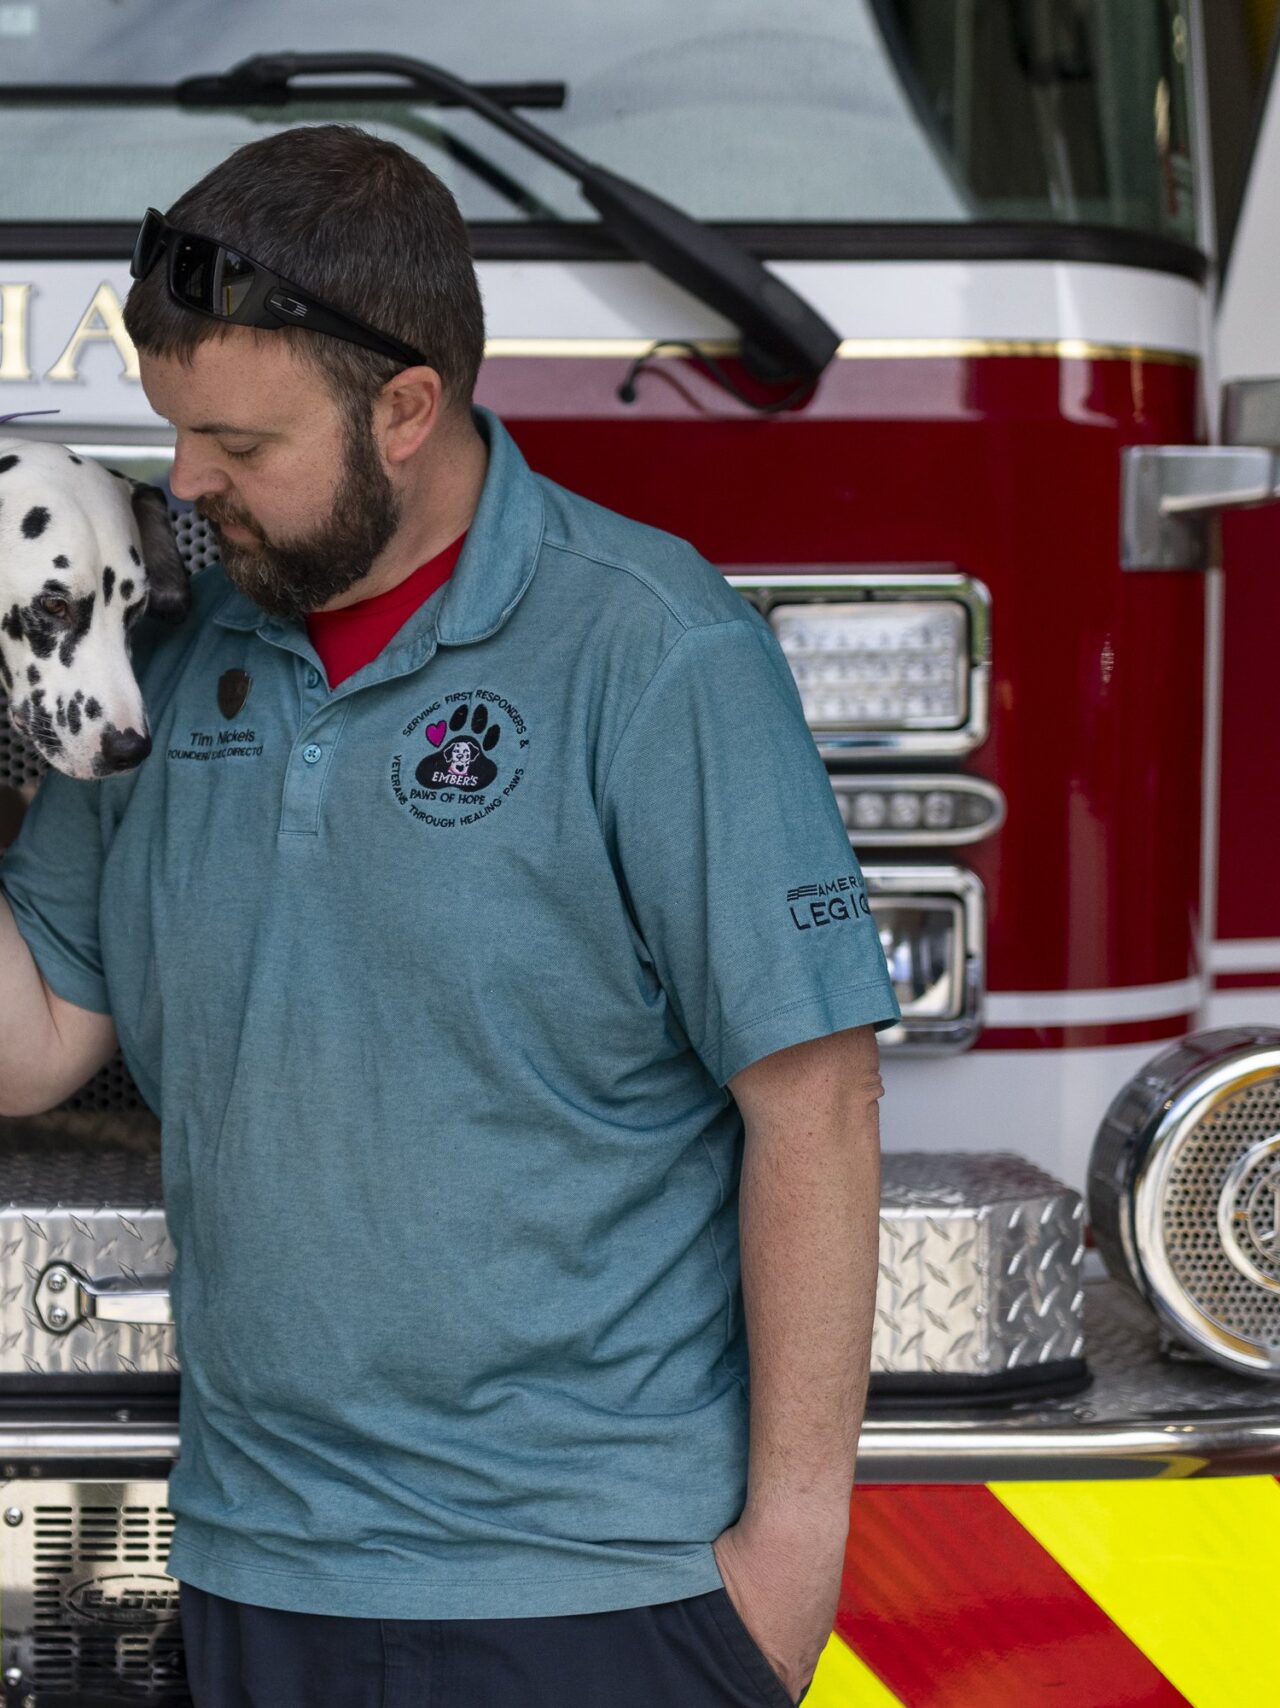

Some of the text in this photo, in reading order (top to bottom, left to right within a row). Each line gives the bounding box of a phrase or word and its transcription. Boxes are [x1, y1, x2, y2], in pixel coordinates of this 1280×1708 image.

[402, 689, 529, 749] SERVING FIRST RESPONDERS &
[190, 733, 212, 746] Tim
[227, 745, 264, 757] DIRECTO
[431, 771, 478, 786] EMBER'S
[391, 754, 524, 827] VETERANS THROUGH HEALING PAWS
[410, 789, 485, 805] PAWS OF HOPE
[790, 893, 871, 930] LEGIO
